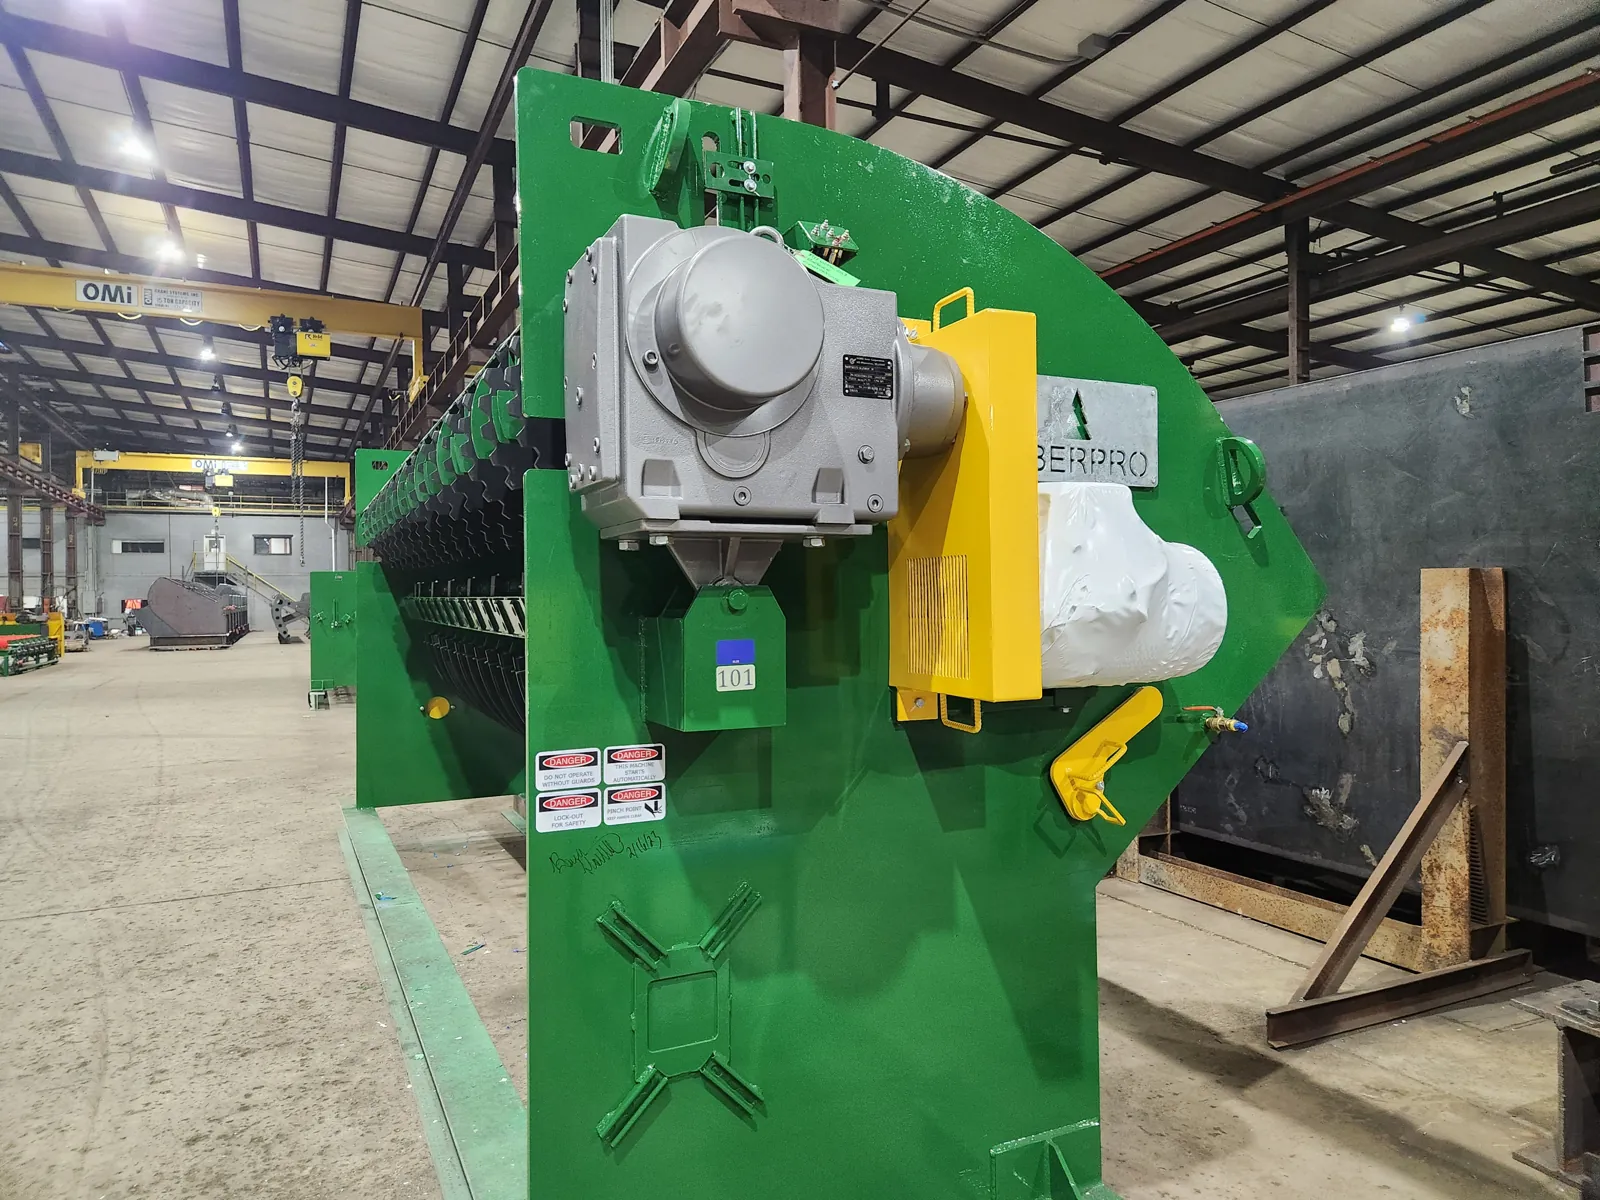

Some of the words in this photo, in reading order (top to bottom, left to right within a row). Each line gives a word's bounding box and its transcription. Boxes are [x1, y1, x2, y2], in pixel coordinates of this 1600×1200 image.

[718, 668, 753, 688] 101
[617, 750, 652, 759] DANGER
[549, 756, 587, 766] DANGER
[624, 768, 645, 776] STARTS
[542, 780, 570, 788] WITHOUT
[571, 777, 595, 785] GUARDS
[612, 775, 656, 783] AUTOMATICALLY
[617, 790, 652, 800] DANGER
[549, 797, 587, 807] DANGER
[553, 813, 583, 821] LOCK-OUT
[564, 820, 586, 828] SAFETY
